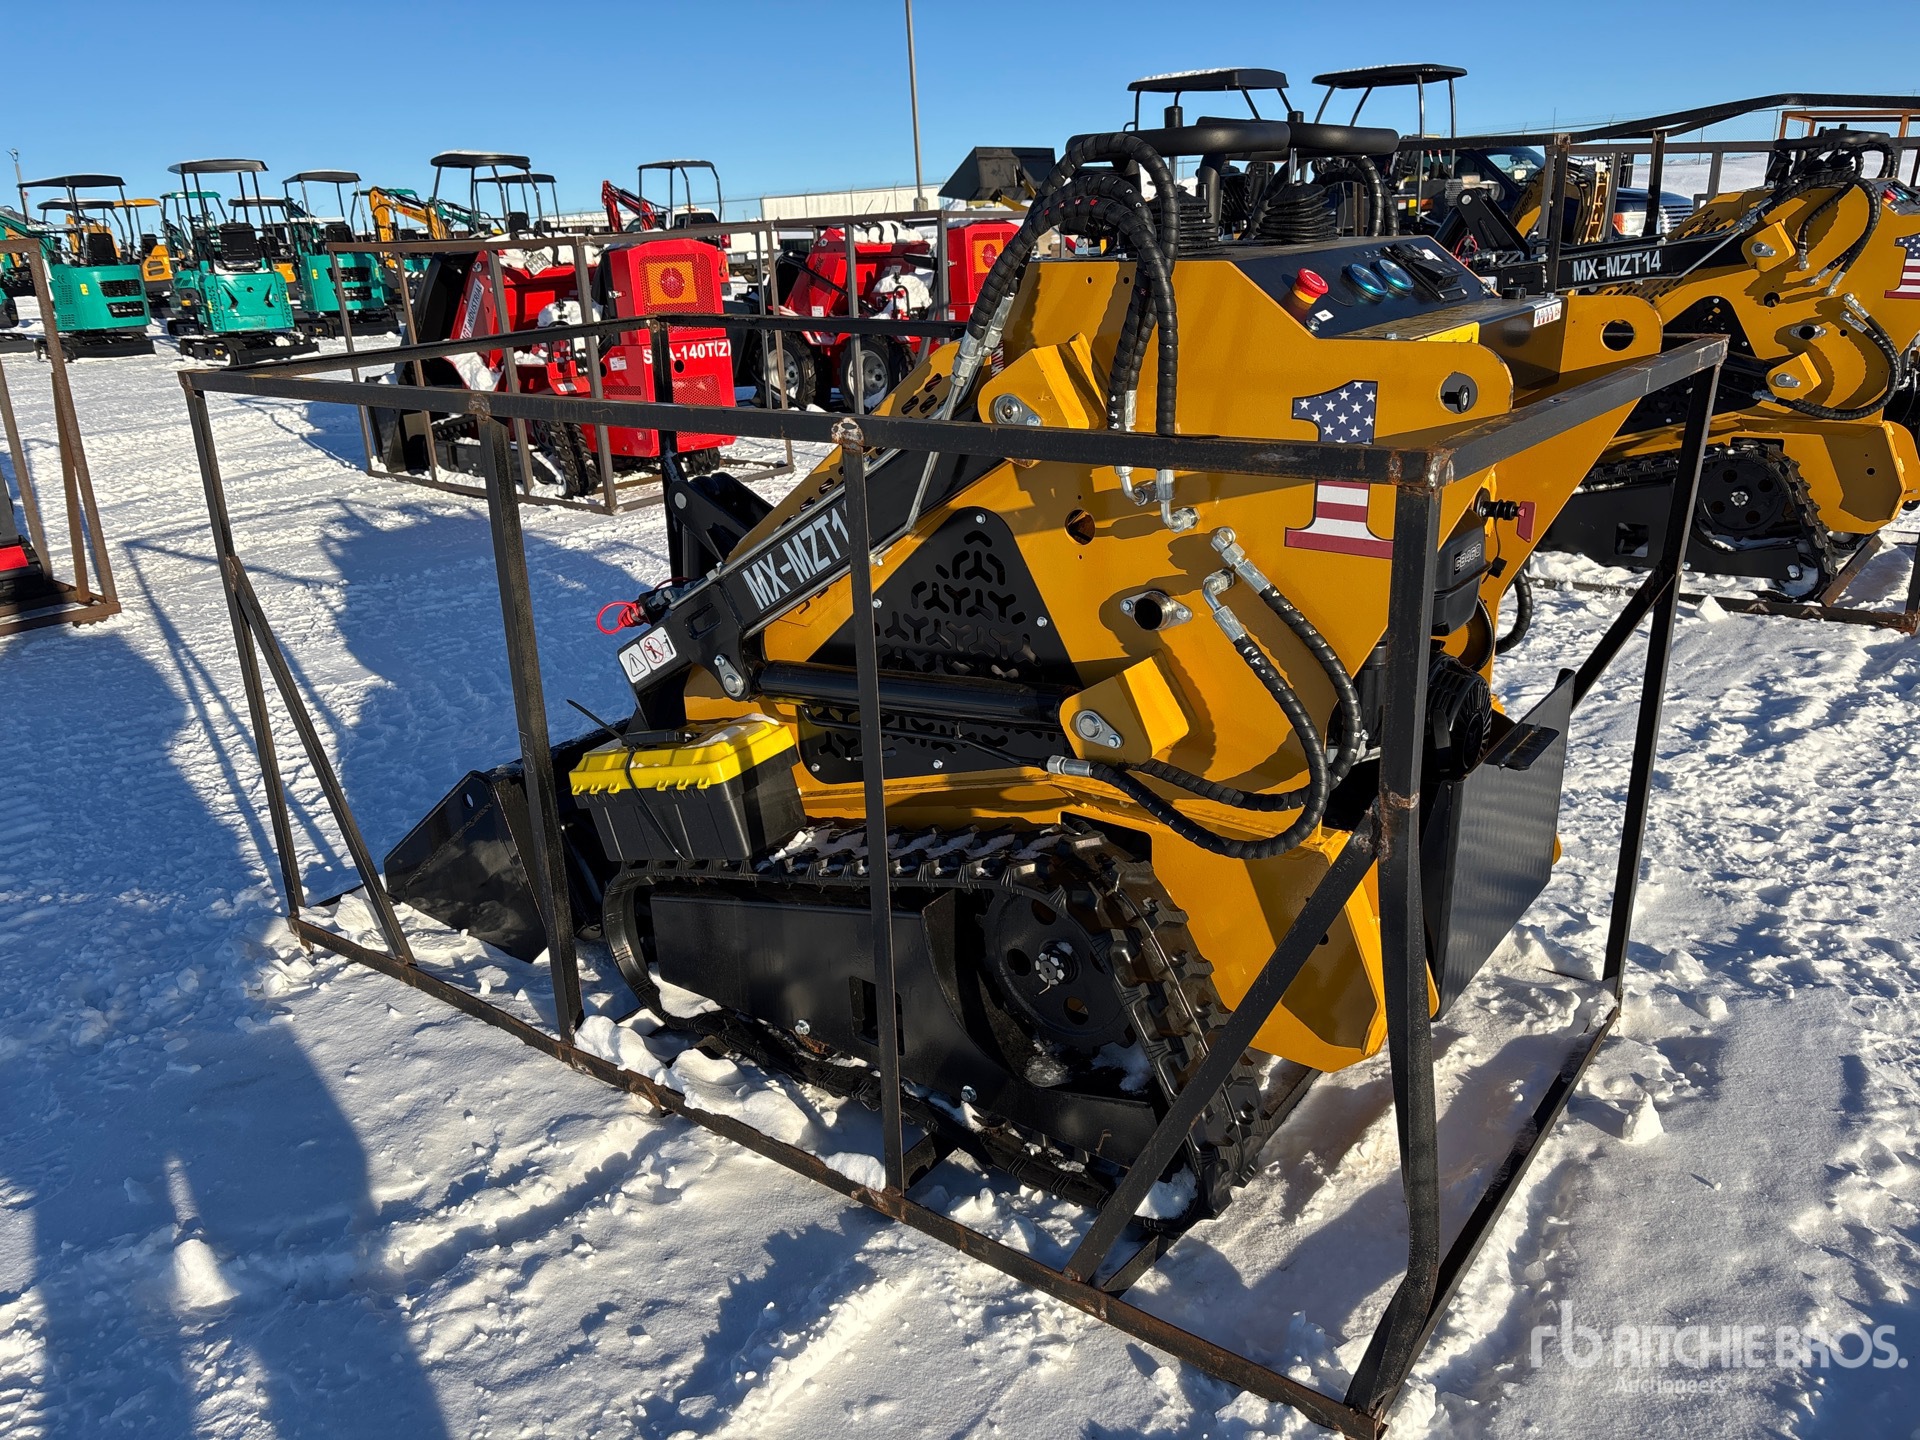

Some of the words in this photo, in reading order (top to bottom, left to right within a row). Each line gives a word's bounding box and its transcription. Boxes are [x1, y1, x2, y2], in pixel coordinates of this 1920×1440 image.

[1573, 250, 1661, 282] MX-MZT14
[466, 284, 482, 328] INDUSTRIAL
[643, 339, 731, 364] SA-140T(Z)
[742, 499, 849, 610] MX-MZT1
